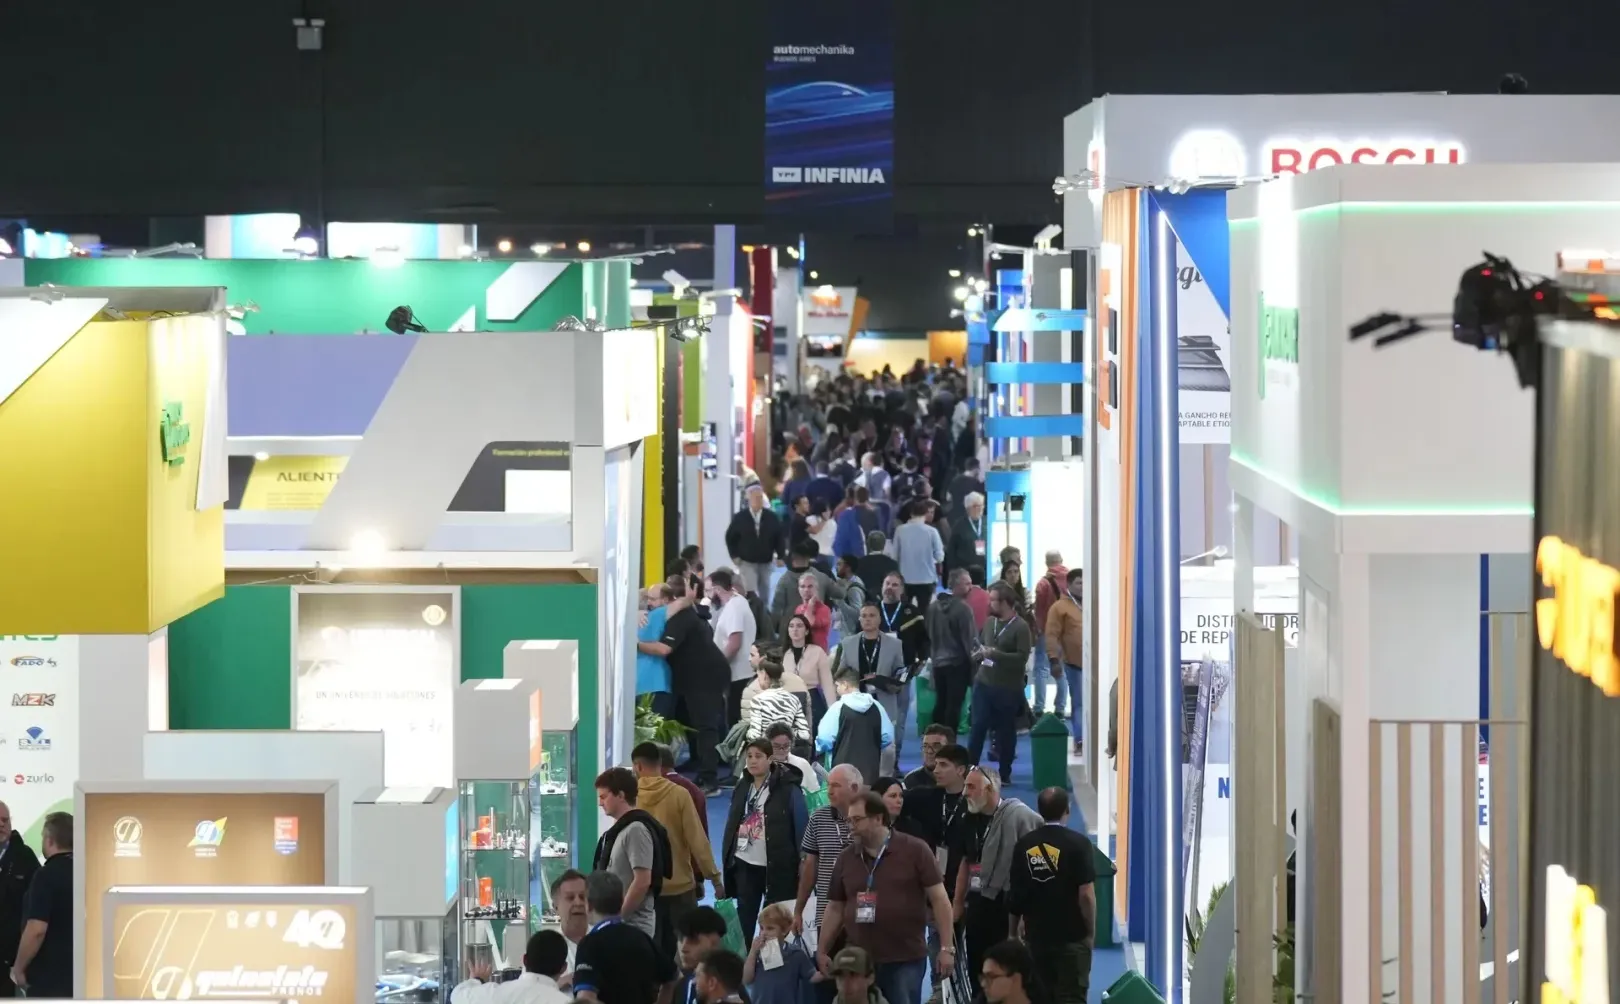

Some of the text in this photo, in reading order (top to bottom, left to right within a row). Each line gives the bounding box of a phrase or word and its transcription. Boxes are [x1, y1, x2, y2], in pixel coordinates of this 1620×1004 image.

[773, 44, 855, 56] automechanika
[804, 167, 886, 184] INFINIA
[277, 471, 340, 482] ALIENT
[12, 692, 56, 706] MZK
[26, 773, 55, 783] zurlo
